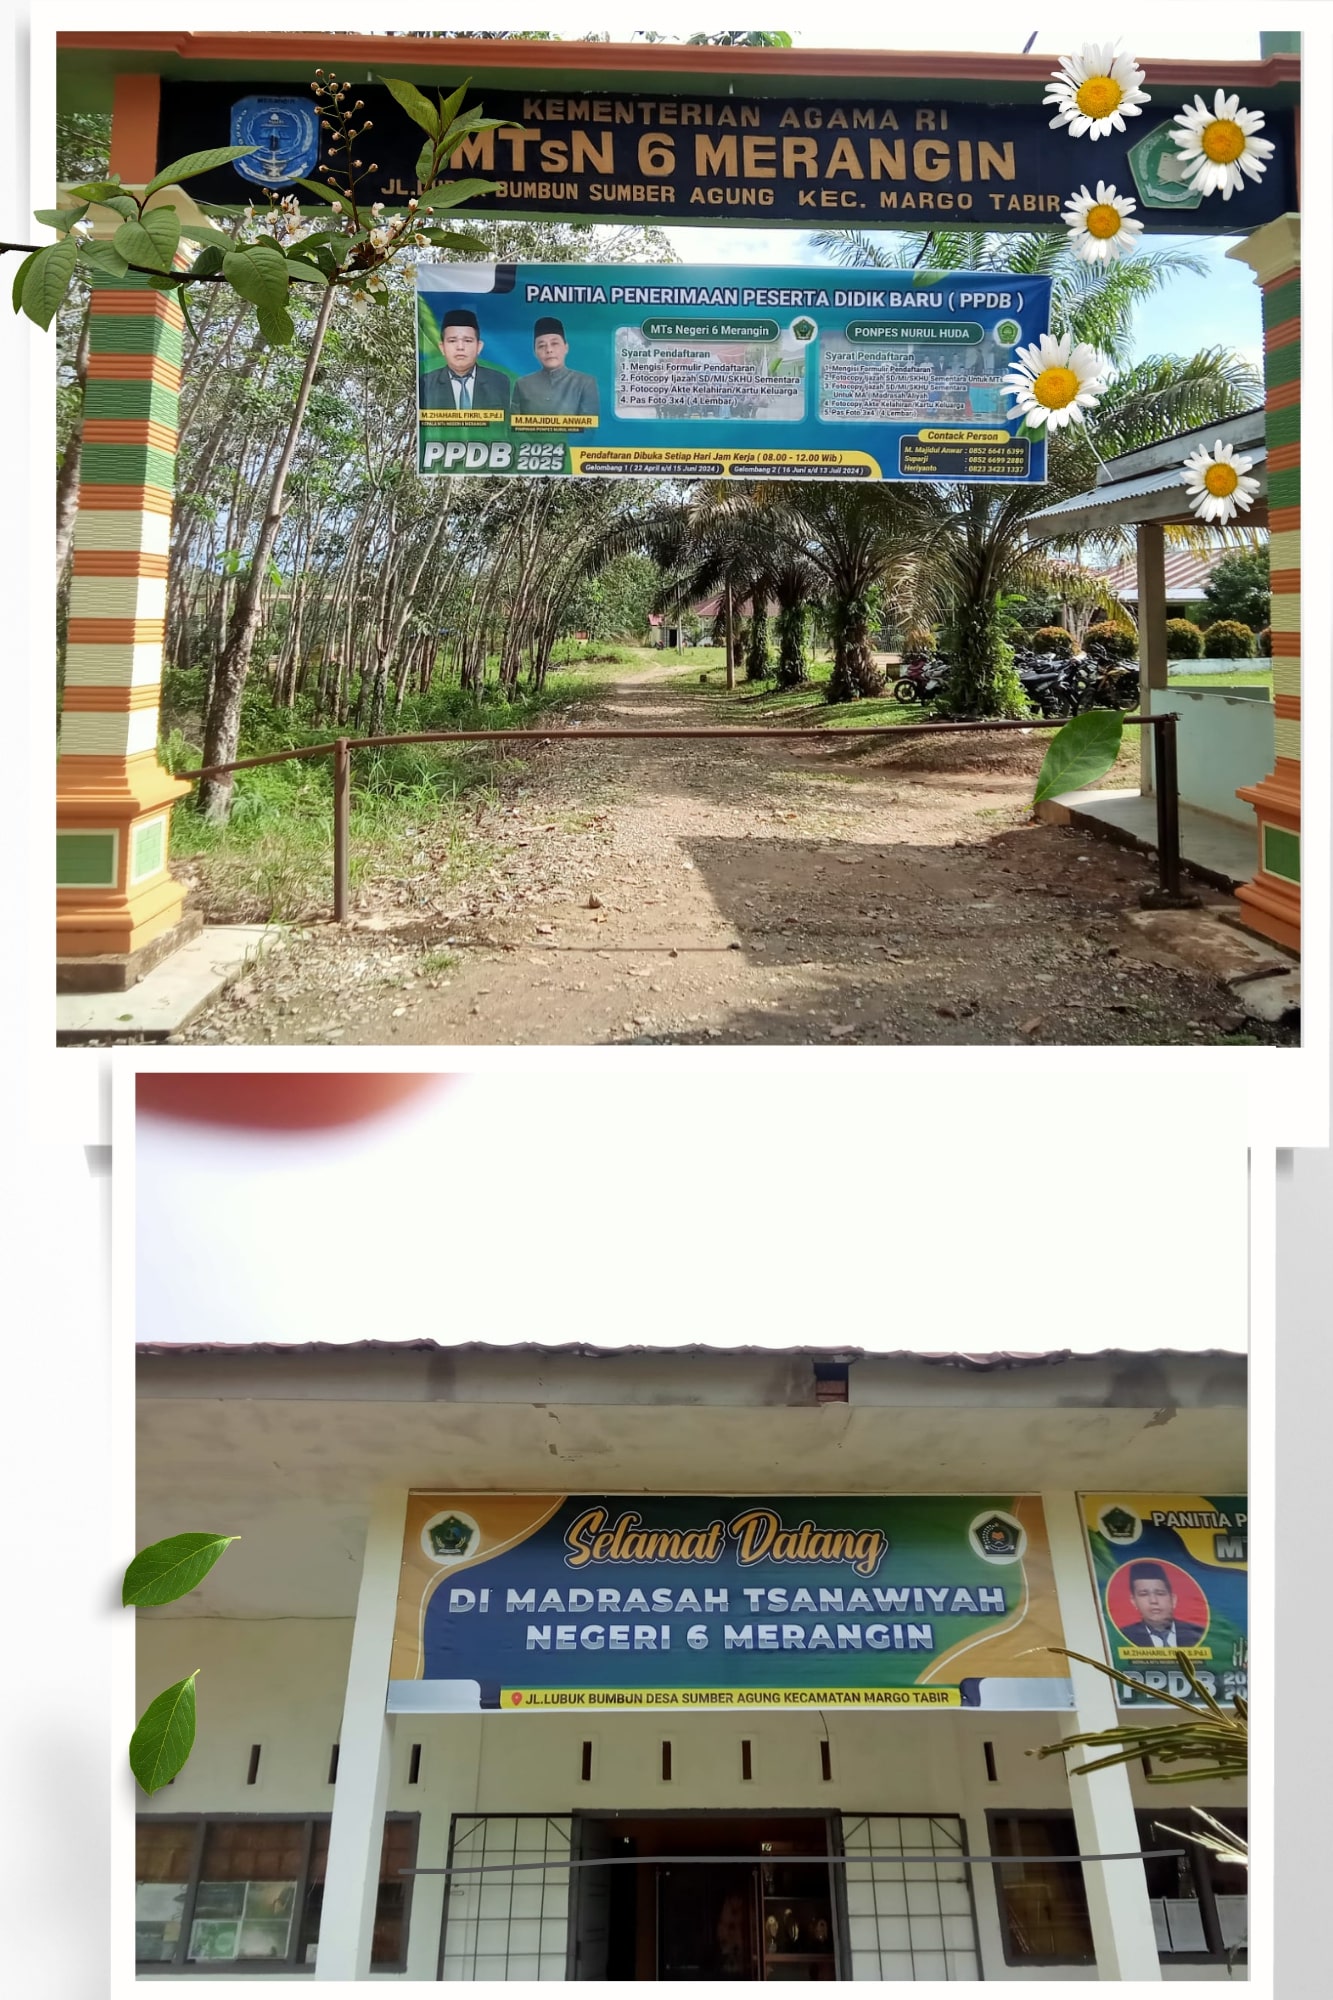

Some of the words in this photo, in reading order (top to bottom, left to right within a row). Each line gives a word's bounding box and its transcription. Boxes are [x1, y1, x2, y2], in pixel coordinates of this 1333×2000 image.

[523, 98, 761, 128] KEMENTERIAN
[779, 106, 899, 131] AGAMA
[915, 108, 949, 131] RI
[450, 126, 615, 175] MTsN
[637, 132, 676, 177] 6
[694, 133, 1016, 182] MERANGIN
[495, 180, 579, 200] BUMBUN
[589, 183, 676, 203] SUMBER
[689, 186, 775, 205] AGUNG
[798, 189, 866, 209] KEC.
[880, 191, 973, 210] MARGO
[989, 193, 1060, 212] TABIR
[526, 285, 606, 302] PANITIA
[611, 287, 738, 305] PENERIMAAN
[743, 290, 829, 307] PESERTA
[834, 291, 886, 308] DIDIK
[889, 292, 943, 308] BARU
[960, 293, 1012, 309] PPDB
[650, 324, 673, 334] MTs
[675, 325, 709, 336] Negeri
[711, 325, 719, 334] 6
[721, 325, 769, 337] Merangin
[854, 327, 898, 338] PONPES
[901, 328, 937, 338] NURUL
[939, 329, 970, 339] HUDA
[621, 348, 651, 358] Syarat
[653, 349, 710, 358] Pendaftaran
[825, 351, 855, 361] Syarat
[857, 352, 914, 361] Pendaftaran
[621, 363, 629, 371] 1.
[630, 363, 664, 372] Mengisi
[666, 363, 702, 371] Formulir
[703, 364, 755, 372] Pendaftaran
[620, 374, 629, 382] 2.
[630, 374, 668, 383] Fotocopy
[671, 374, 696, 383] Ijazah
[698, 375, 752, 383] SD/MI/SKHU
[754, 375, 800, 384] Sementara
[620, 385, 629, 393] 3.
[630, 385, 669, 394] Fotocopy
[671, 385, 691, 393] Akte
[692, 386, 758, 394] Kelahiran/Kartu
[760, 387, 798, 396] Keluarga
[620, 396, 629, 404] 4.
[630, 396, 646, 404] Pas
[648, 396, 667, 404] Foto
[669, 396, 684, 404] 3x4
[421, 412, 463, 420] M.ZHAHARIL
[514, 416, 561, 425] M.MAJIDUL
[562, 417, 593, 425] ANWAR
[927, 431, 965, 440] Contack
[966, 432, 999, 441] Person
[423, 442, 512, 468] PPDB
[518, 443, 565, 457] 2024
[914, 446, 940, 455] Majidul
[580, 450, 632, 460] Pendaftaran
[633, 451, 663, 460] Dibuka
[664, 452, 692, 462] Setiap
[693, 452, 711, 461] Hari
[713, 452, 731, 461] Jam
[733, 452, 755, 463] Kerja
[762, 453, 787, 462] 08.00
[796, 453, 820, 462] 12.00
[821, 453, 837, 462] Wib
[904, 455, 929, 464] Suparji
[516, 456, 563, 470] 2025
[585, 464, 623, 473] Gelombang
[634, 464, 642, 472] 22
[643, 464, 660, 473] April
[683, 465, 698, 473] Juni
[904, 464, 937, 473] Heriyanto
[734, 466, 771, 474] Gelombang
[791, 466, 806, 474] Juni
[1152, 1512, 1232, 1528] PANITIA
[566, 1507, 724, 1567] Selamat
[730, 1509, 886, 1575] Datang
[448, 1588, 490, 1613] DI
[505, 1588, 730, 1613] MADRASAH
[743, 1587, 1006, 1612] TSANAWIYAH
[525, 1624, 671, 1650] NEGERI
[686, 1624, 709, 1650] 6
[723, 1623, 934, 1650] MERANGIN
[1122, 1670, 1217, 1699] PPDB
[525, 1692, 586, 1705] JL.LUBUK
[588, 1693, 643, 1705] BUMBUN
[645, 1693, 679, 1704] DESA
[681, 1692, 734, 1704] SUMBER
[737, 1692, 781, 1704] AGUNG
[784, 1692, 860, 1704] KECAMATAN
[863, 1692, 910, 1704] MARGO
[912, 1692, 949, 1703] TABIR
